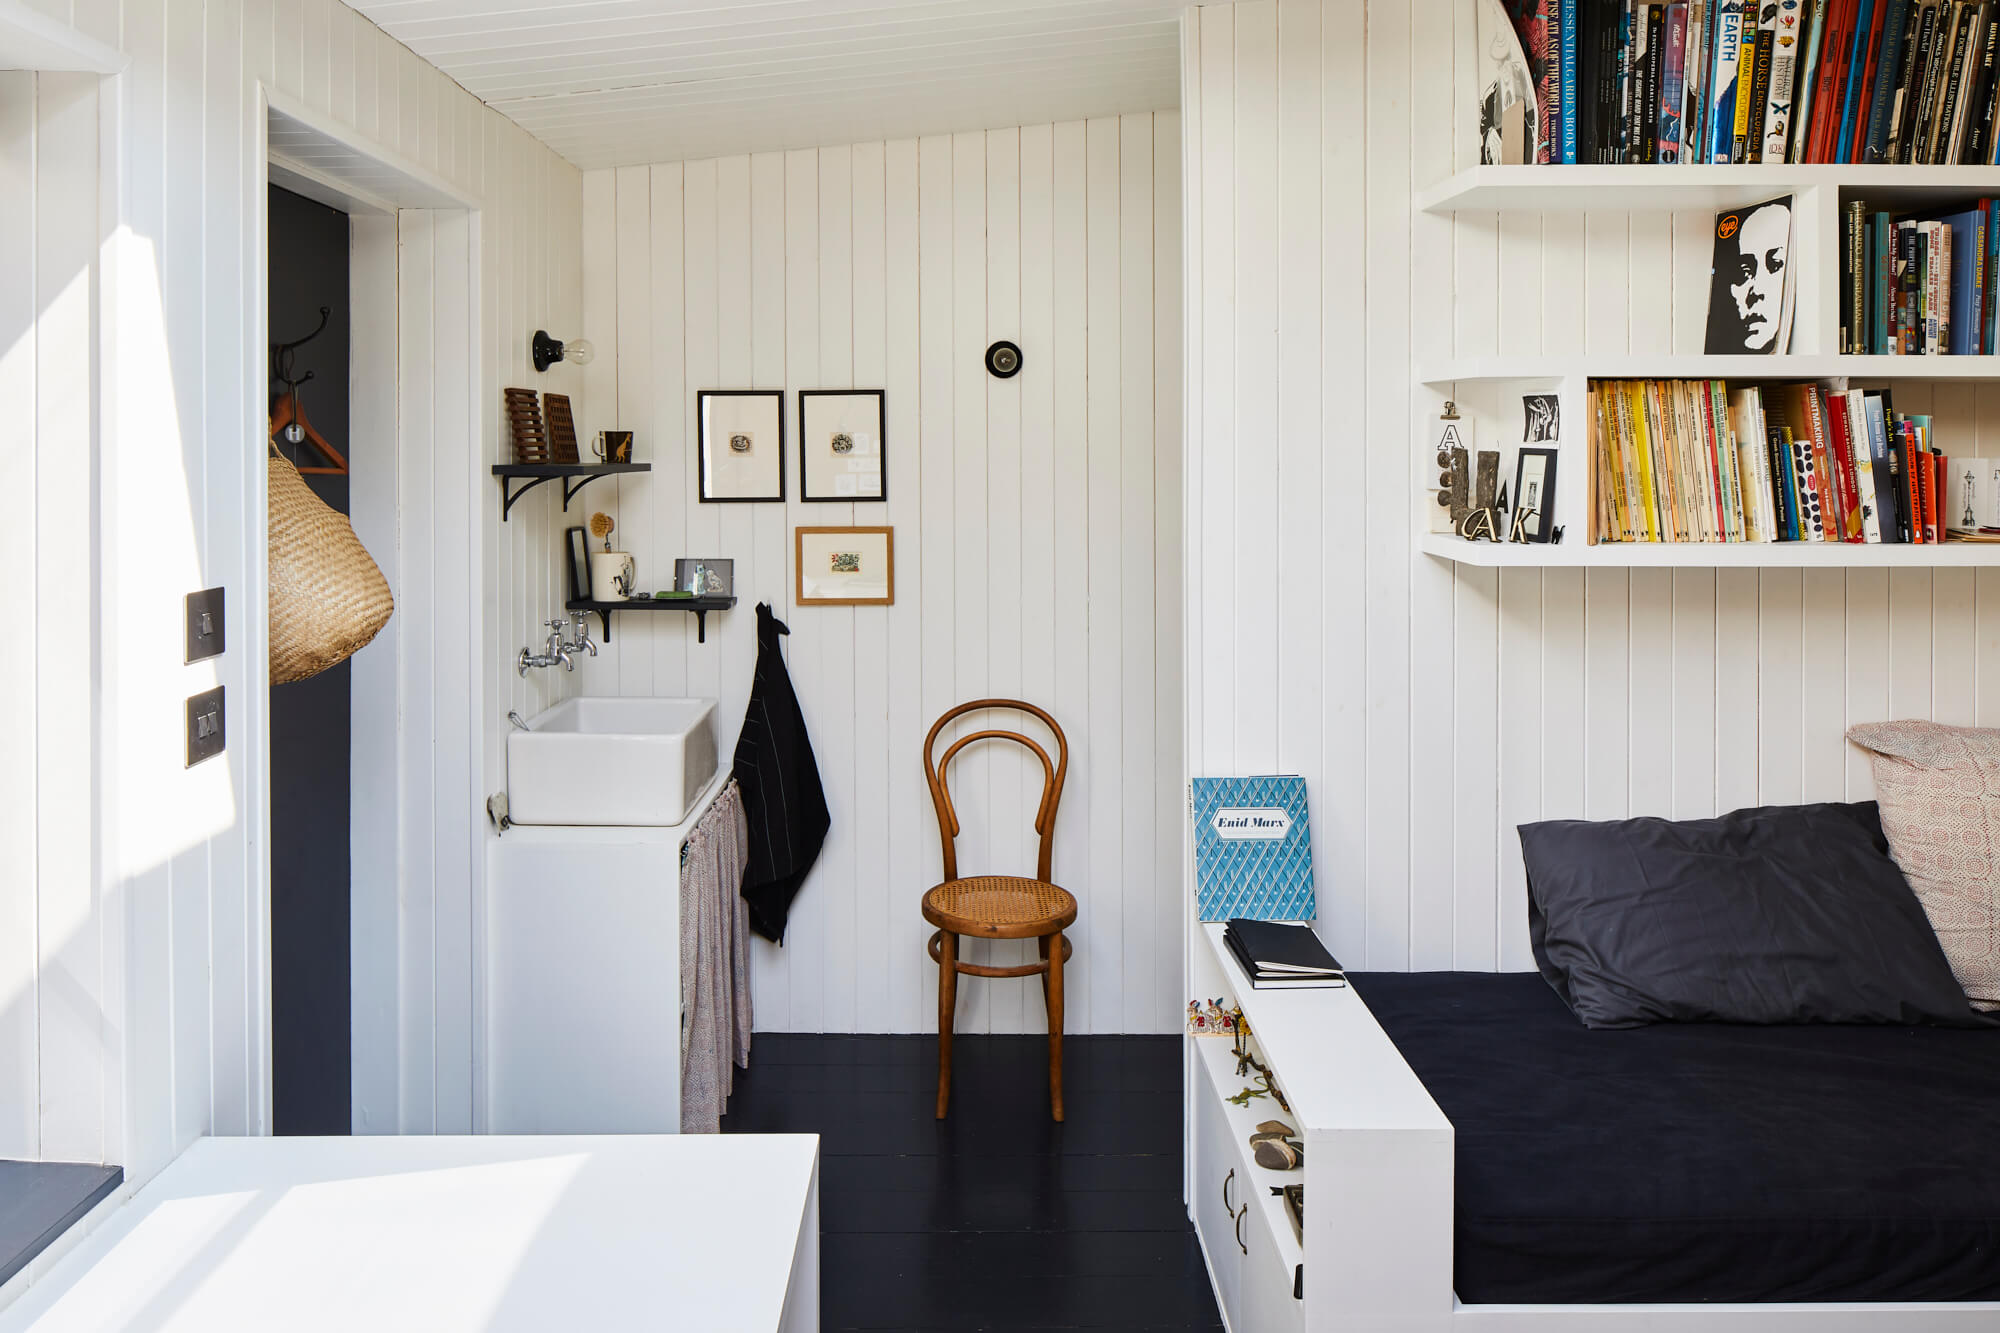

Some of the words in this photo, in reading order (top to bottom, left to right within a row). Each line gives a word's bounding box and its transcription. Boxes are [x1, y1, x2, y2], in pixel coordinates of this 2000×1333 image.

[1923, 10, 1934, 26] Ernst
[1547, 21, 1560, 48] ATLAS
[1565, 6, 1575, 69] ESSENTIAL
[1721, 15, 1739, 62] EARTH
[1986, 22, 1999, 50] ROMAN
[1547, 50, 1560, 59] OF
[1742, 48, 1752, 78] ANIMAL
[1757, 49, 1770, 89] HORSE
[1951, 58, 1961, 78] BIBLE
[1984, 51, 1993, 69] ART
[1547, 60, 1560, 81] THE
[1775, 56, 1784, 97] HISTORY
[1783, 56, 1791, 98] NATURAL
[1547, 81, 1559, 114] WORLD
[1565, 69, 1575, 116] GARDEN
[1737, 79, 1750, 131] ENCYCLOPEDIA
[1941, 80, 1957, 133] ILLUSTRATIONS
[1565, 117, 1575, 147] BOOK
[1753, 90, 1763, 150] ENCYCLOPEDIA
[1720, 221, 1736, 236] eye
[1976, 226, 1984, 266] CASSANDRA
[1942, 252, 1950, 280] Killing
[1975, 267, 1983, 288] DARKE
[1808, 387, 1824, 449] PRINTMAKING
[1842, 412, 1850, 436] EDWARD
[1885, 408, 1893, 431] People's
[1438, 425, 1465, 451] A
[1845, 438, 1853, 467] BAWDEN'S
[1848, 468, 1856, 493] LONDON
[1495, 479, 1508, 513] A
[1509, 507, 1537, 544] K
[1218, 817, 1248, 828] Enid
[1251, 817, 1285, 828] Marx
